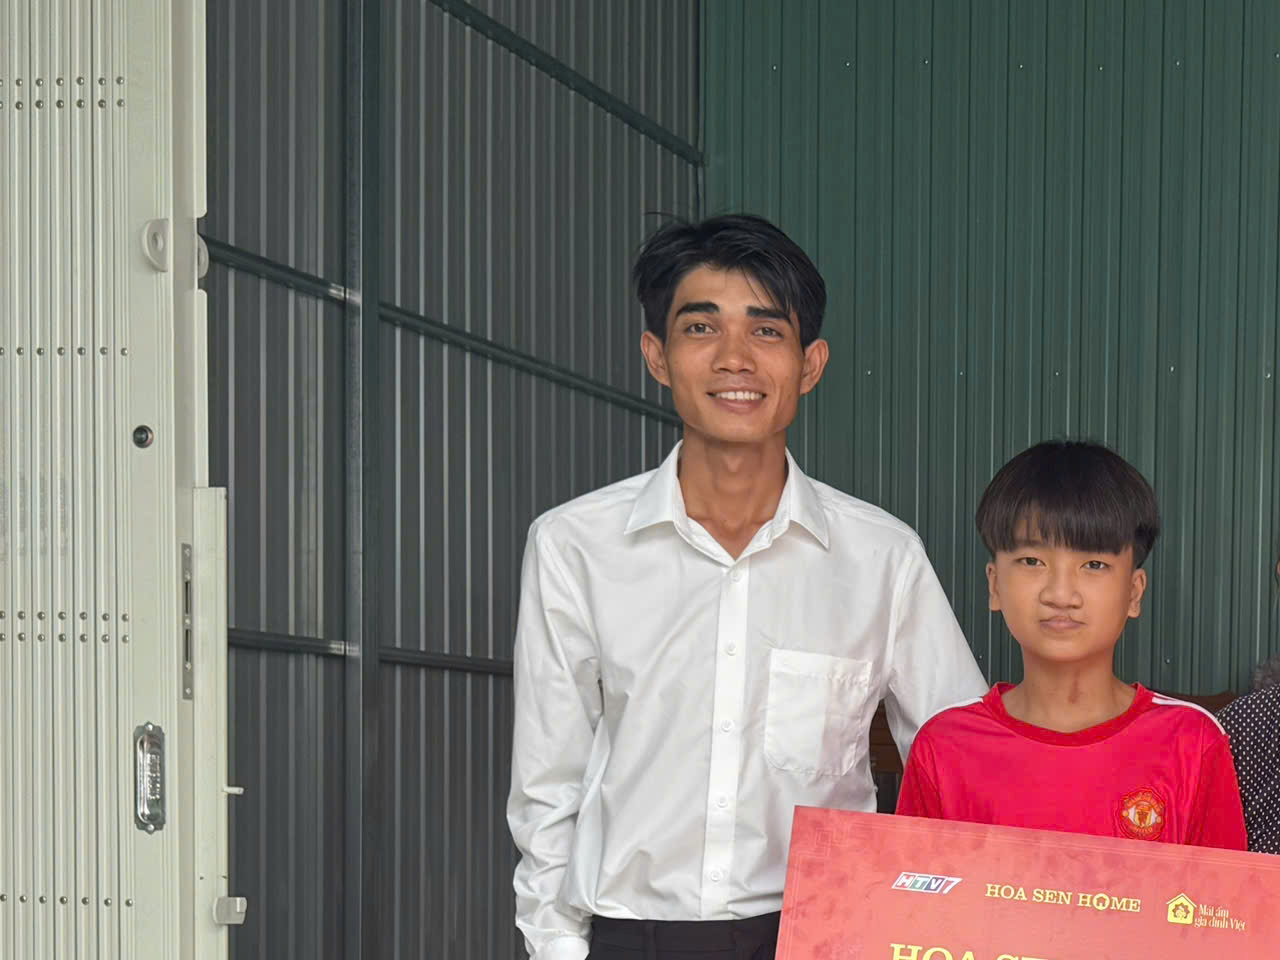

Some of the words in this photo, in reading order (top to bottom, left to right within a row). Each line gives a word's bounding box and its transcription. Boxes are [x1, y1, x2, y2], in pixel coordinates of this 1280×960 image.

[891, 871, 963, 895] HTV7
[985, 883, 1028, 901] HOA
[1032, 887, 1073, 905] SEN
[1077, 892, 1142, 913] HOME
[1198, 903, 1214, 917] Mái
[1194, 915, 1207, 928] gia
[1230, 917, 1246, 932] Việt
